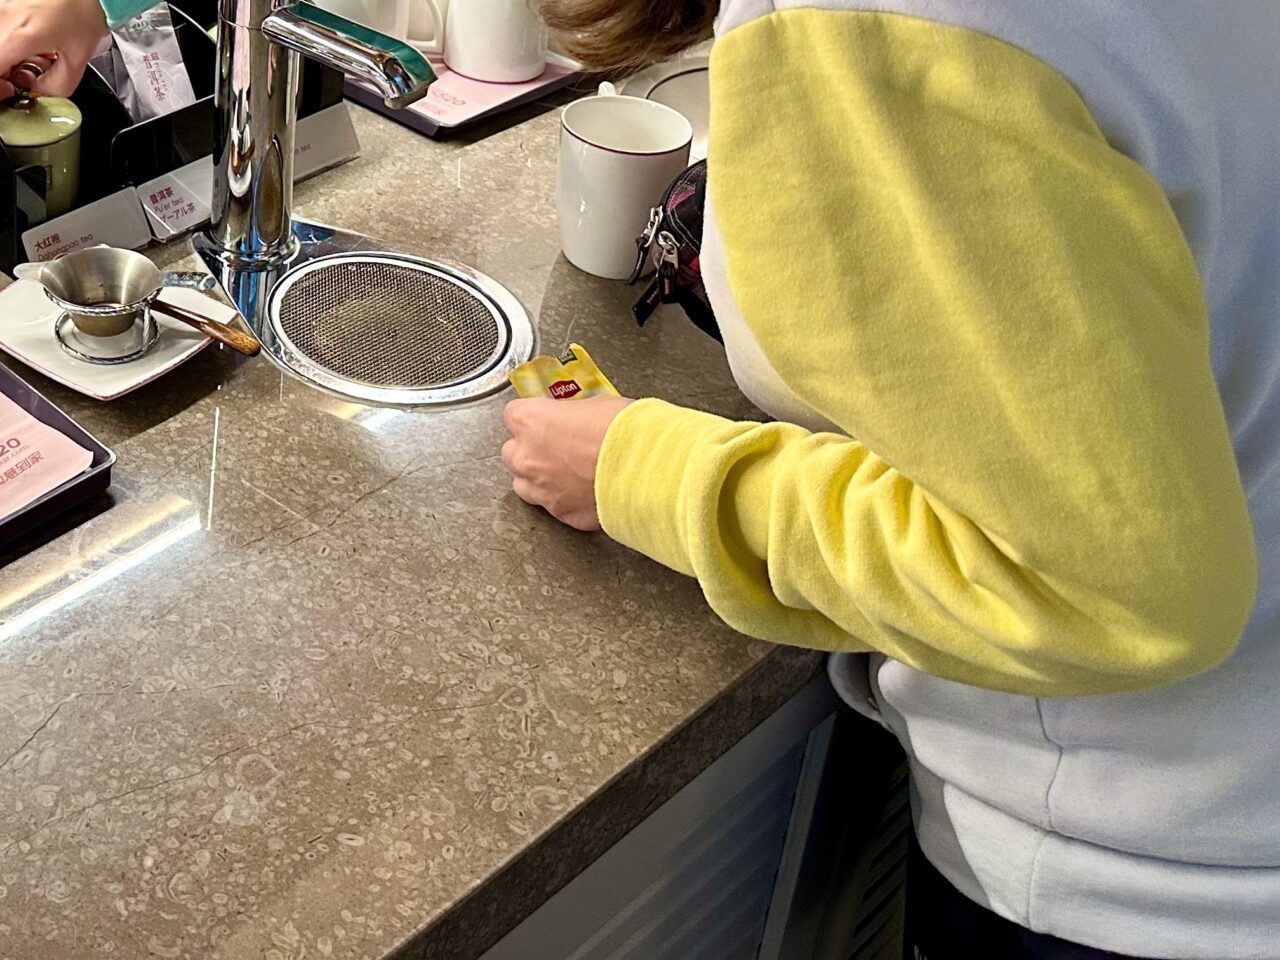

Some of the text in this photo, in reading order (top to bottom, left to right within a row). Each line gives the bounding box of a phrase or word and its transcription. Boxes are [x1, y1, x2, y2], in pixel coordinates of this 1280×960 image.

[149, 187, 174, 205] 普洱茶
[80, 234, 93, 243] tea
[550, 382, 578, 396] Lipton
